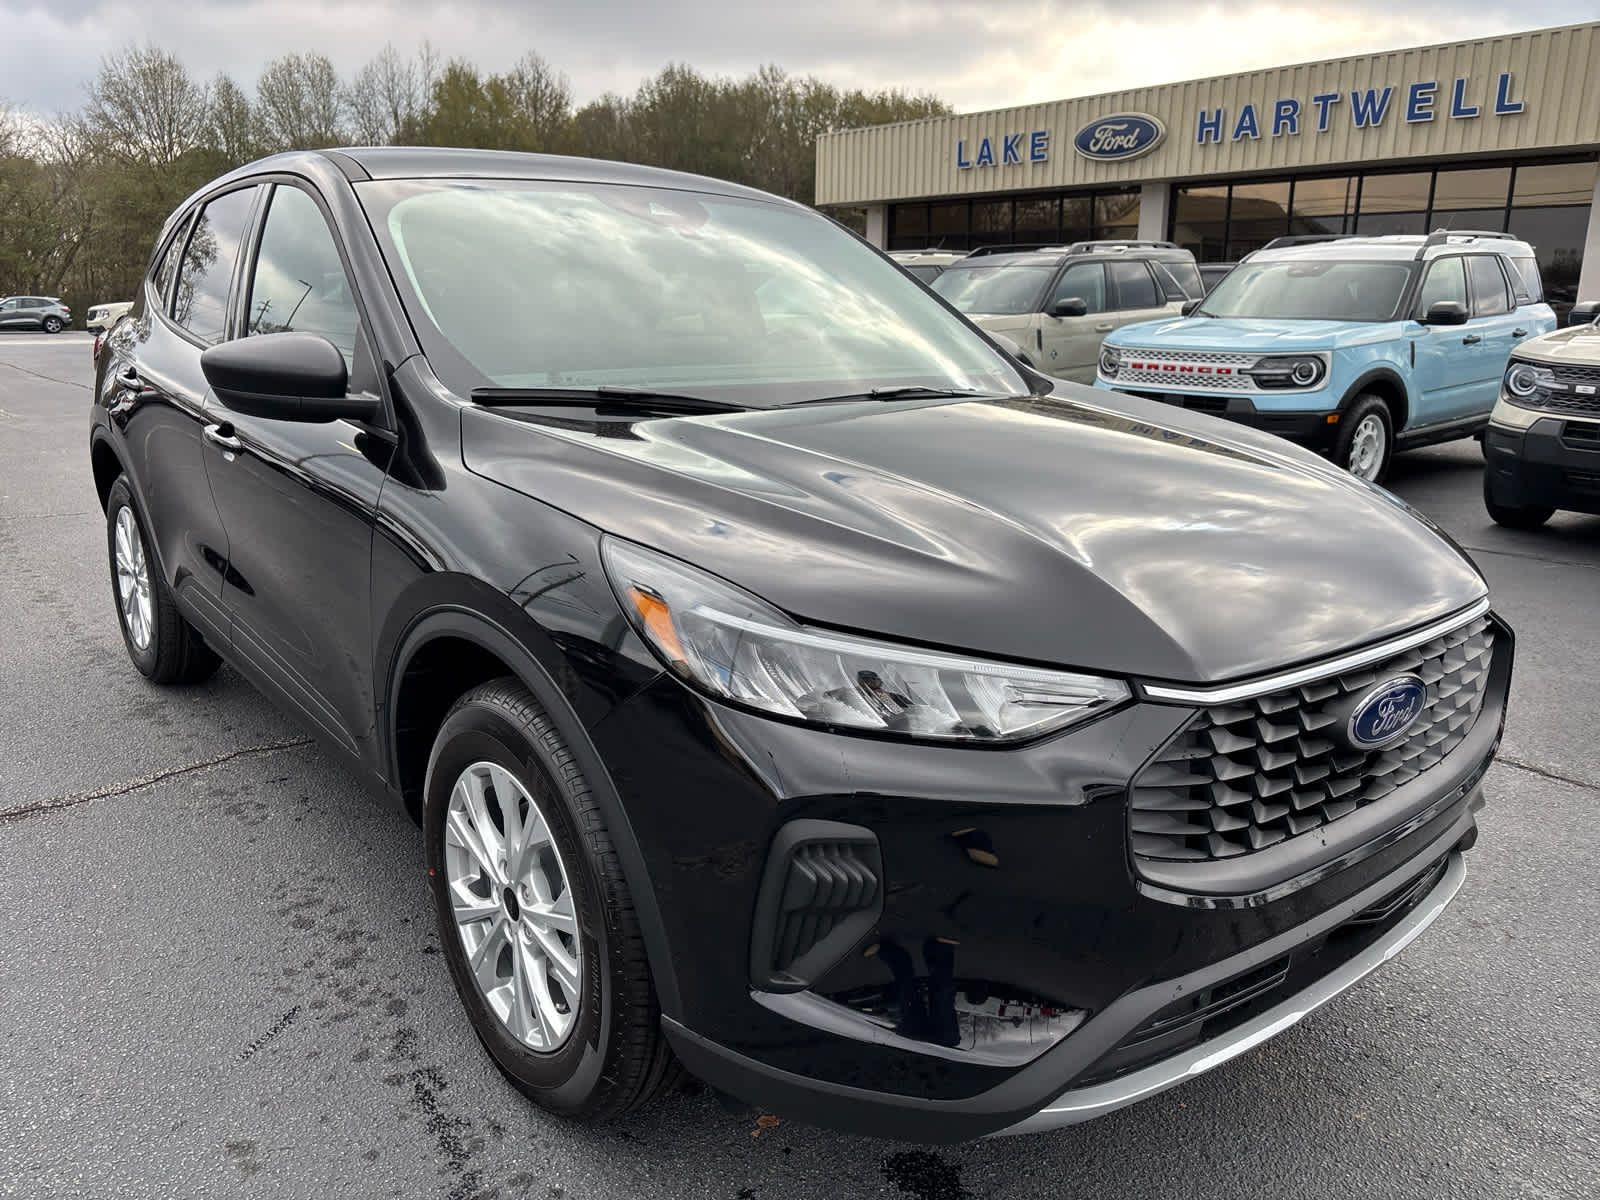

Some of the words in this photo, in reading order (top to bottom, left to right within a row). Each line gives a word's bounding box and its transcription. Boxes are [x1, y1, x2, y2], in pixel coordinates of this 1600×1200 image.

[957, 130, 1049, 169] LAKE
[1196, 72, 1525, 145] HARTWELL
[1131, 362, 1232, 375] BRONCO
